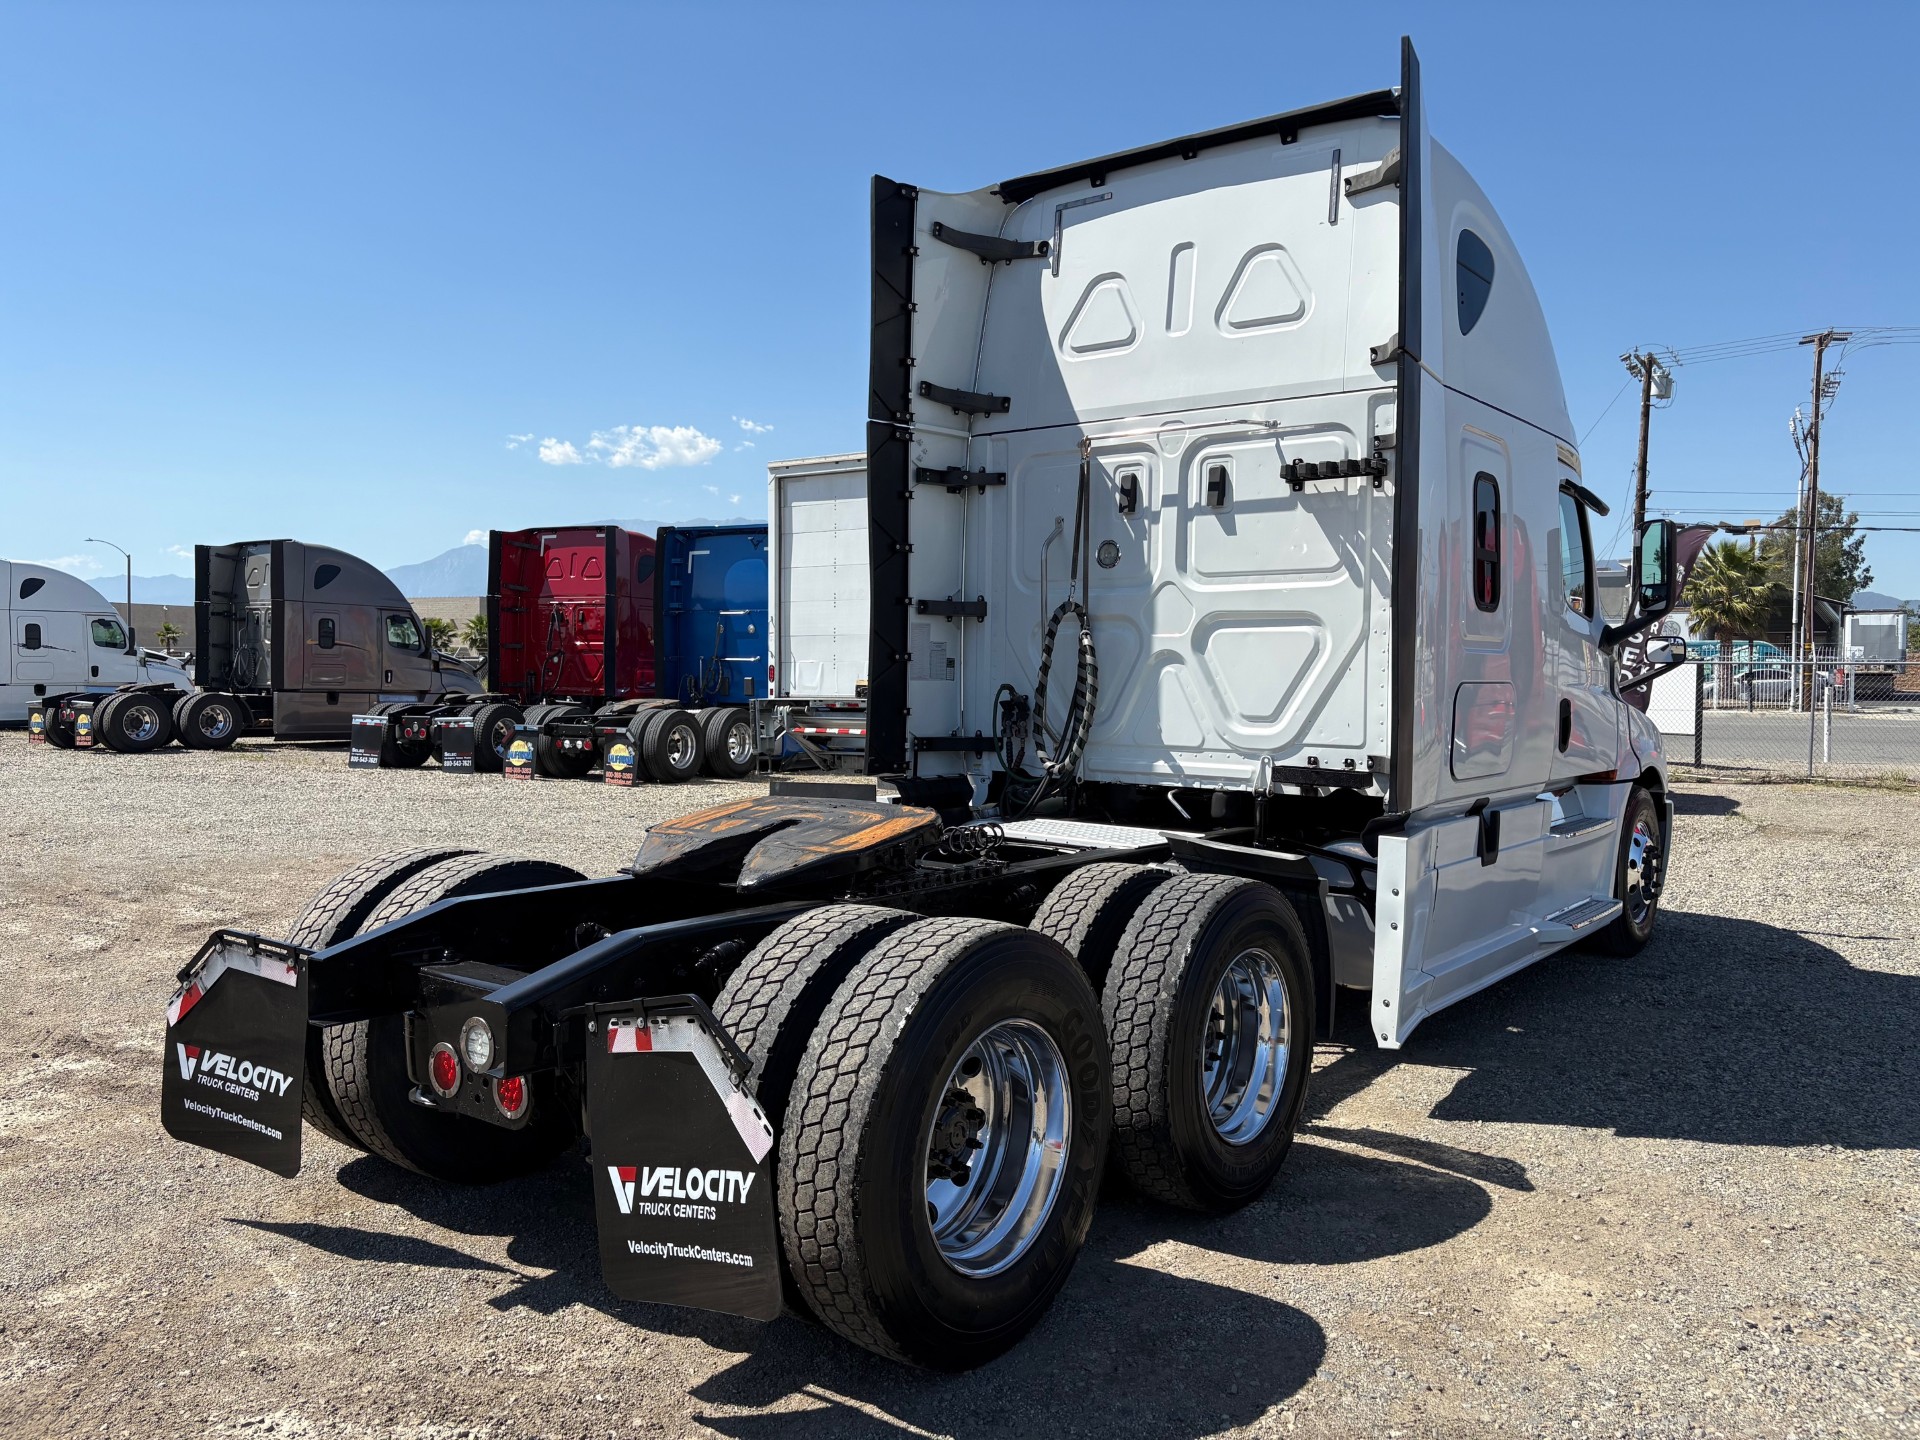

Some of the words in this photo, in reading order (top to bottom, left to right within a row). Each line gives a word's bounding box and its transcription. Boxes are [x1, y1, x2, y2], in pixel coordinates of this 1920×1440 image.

[197, 1074, 223, 1090] TRUCK
[225, 1082, 260, 1101] CENTERS
[200, 1049, 294, 1097] VELOCITY
[184, 1098, 283, 1141] VelocityTruckCenters.com
[641, 1166, 756, 1204] VELOCITY
[639, 1202, 672, 1216] TRUCK
[673, 1204, 717, 1221] CENTERS
[627, 1240, 754, 1268] VelocityTruckCenters.com
